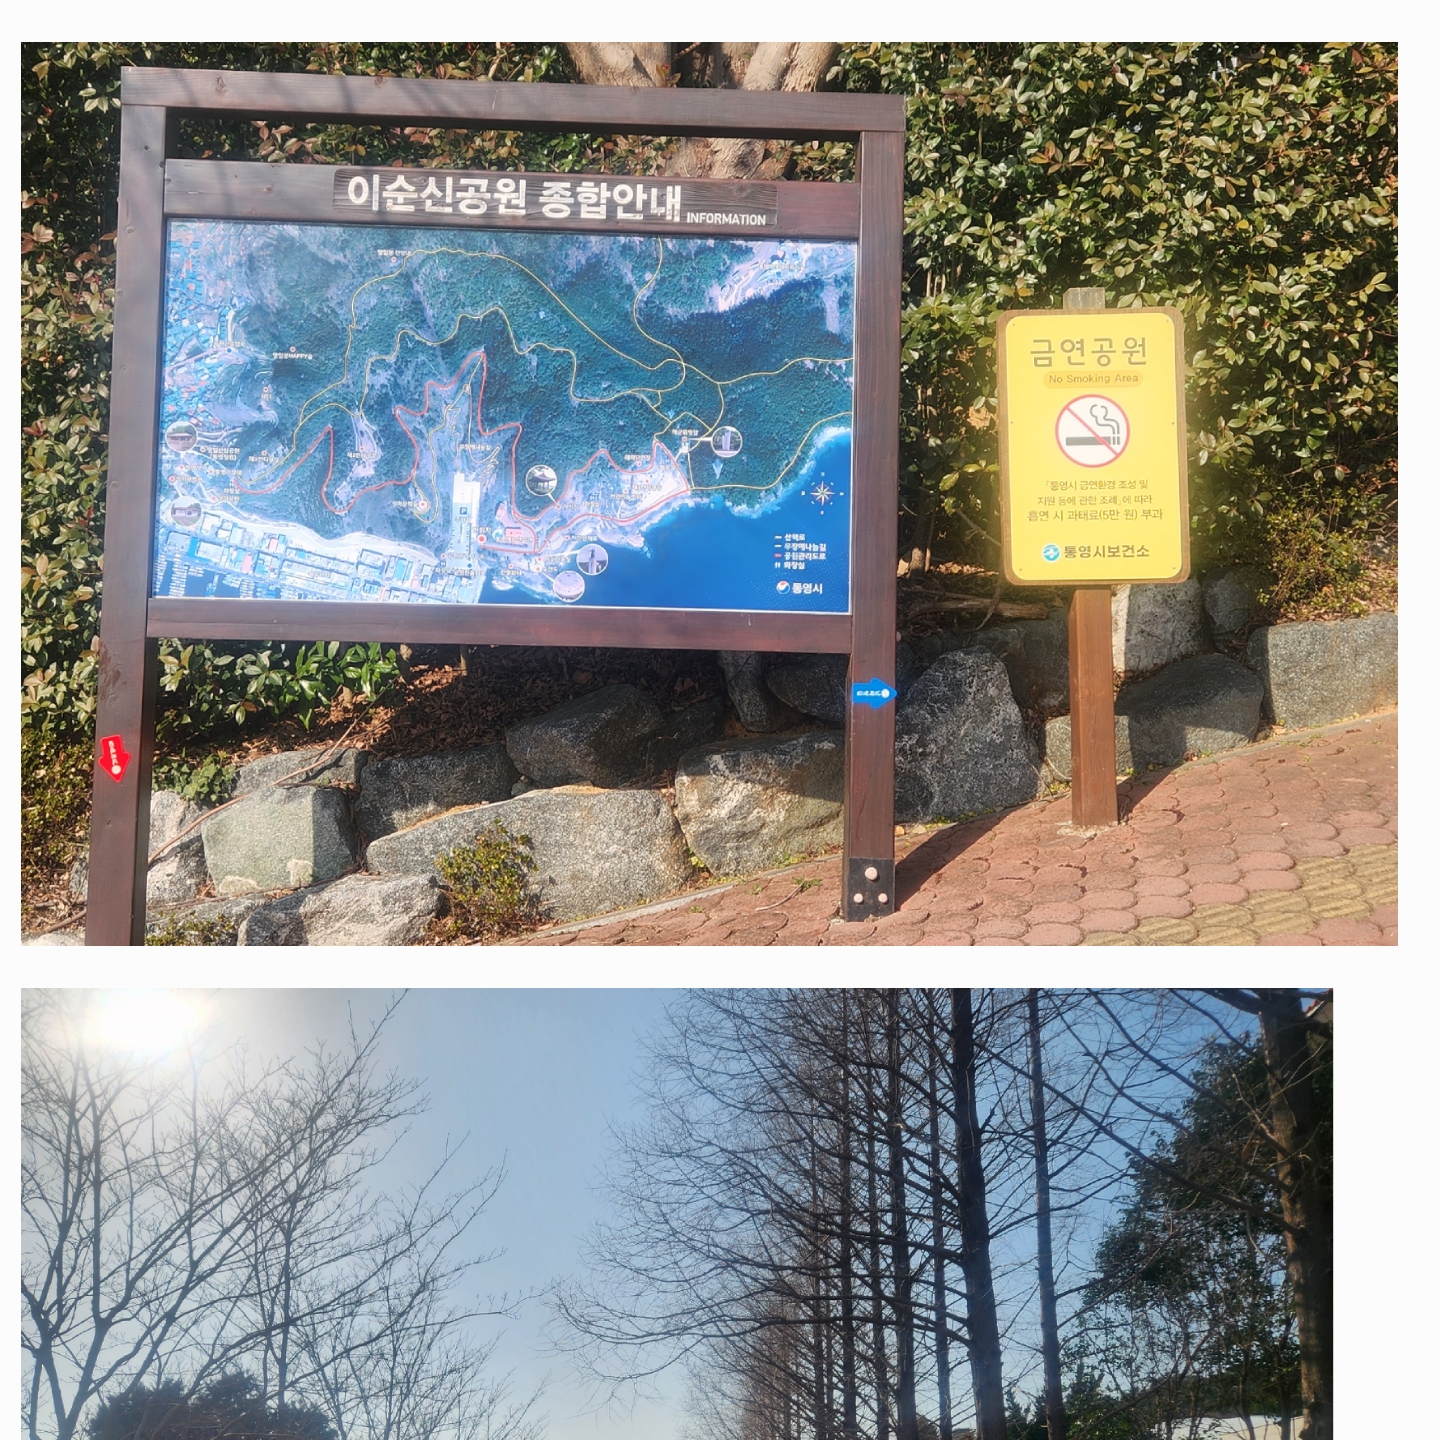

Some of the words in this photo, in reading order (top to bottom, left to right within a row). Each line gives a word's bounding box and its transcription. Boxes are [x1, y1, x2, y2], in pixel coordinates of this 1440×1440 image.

[347, 174, 526, 217] 이순신공원
[538, 181, 682, 222] 종합안내
[686, 211, 766, 226] INFORMATION
[1029, 336, 1148, 368] 금연공원
[1049, 374, 1063, 384] No
[1066, 373, 1111, 384] Smoking
[1114, 373, 1139, 383] Area
[1079, 480, 1116, 491] 금연환경
[1118, 479, 1137, 490] 조성
[1140, 479, 1149, 490] 및
[1037, 496, 1056, 506] 지원
[1058, 495, 1077, 506] 등에
[1079, 495, 1098, 506] 관한
[1134, 494, 1153, 505] 따라
[1027, 510, 1050, 522] 흡연
[1053, 510, 1064, 521] 시
[1066, 508, 1120, 521] 과태료(5만
[1123, 509, 1138, 521] 원)
[1140, 508, 1163, 520] 부과
[1064, 544, 1150, 559] 통영시보건소
[792, 582, 823, 594] 통영시
